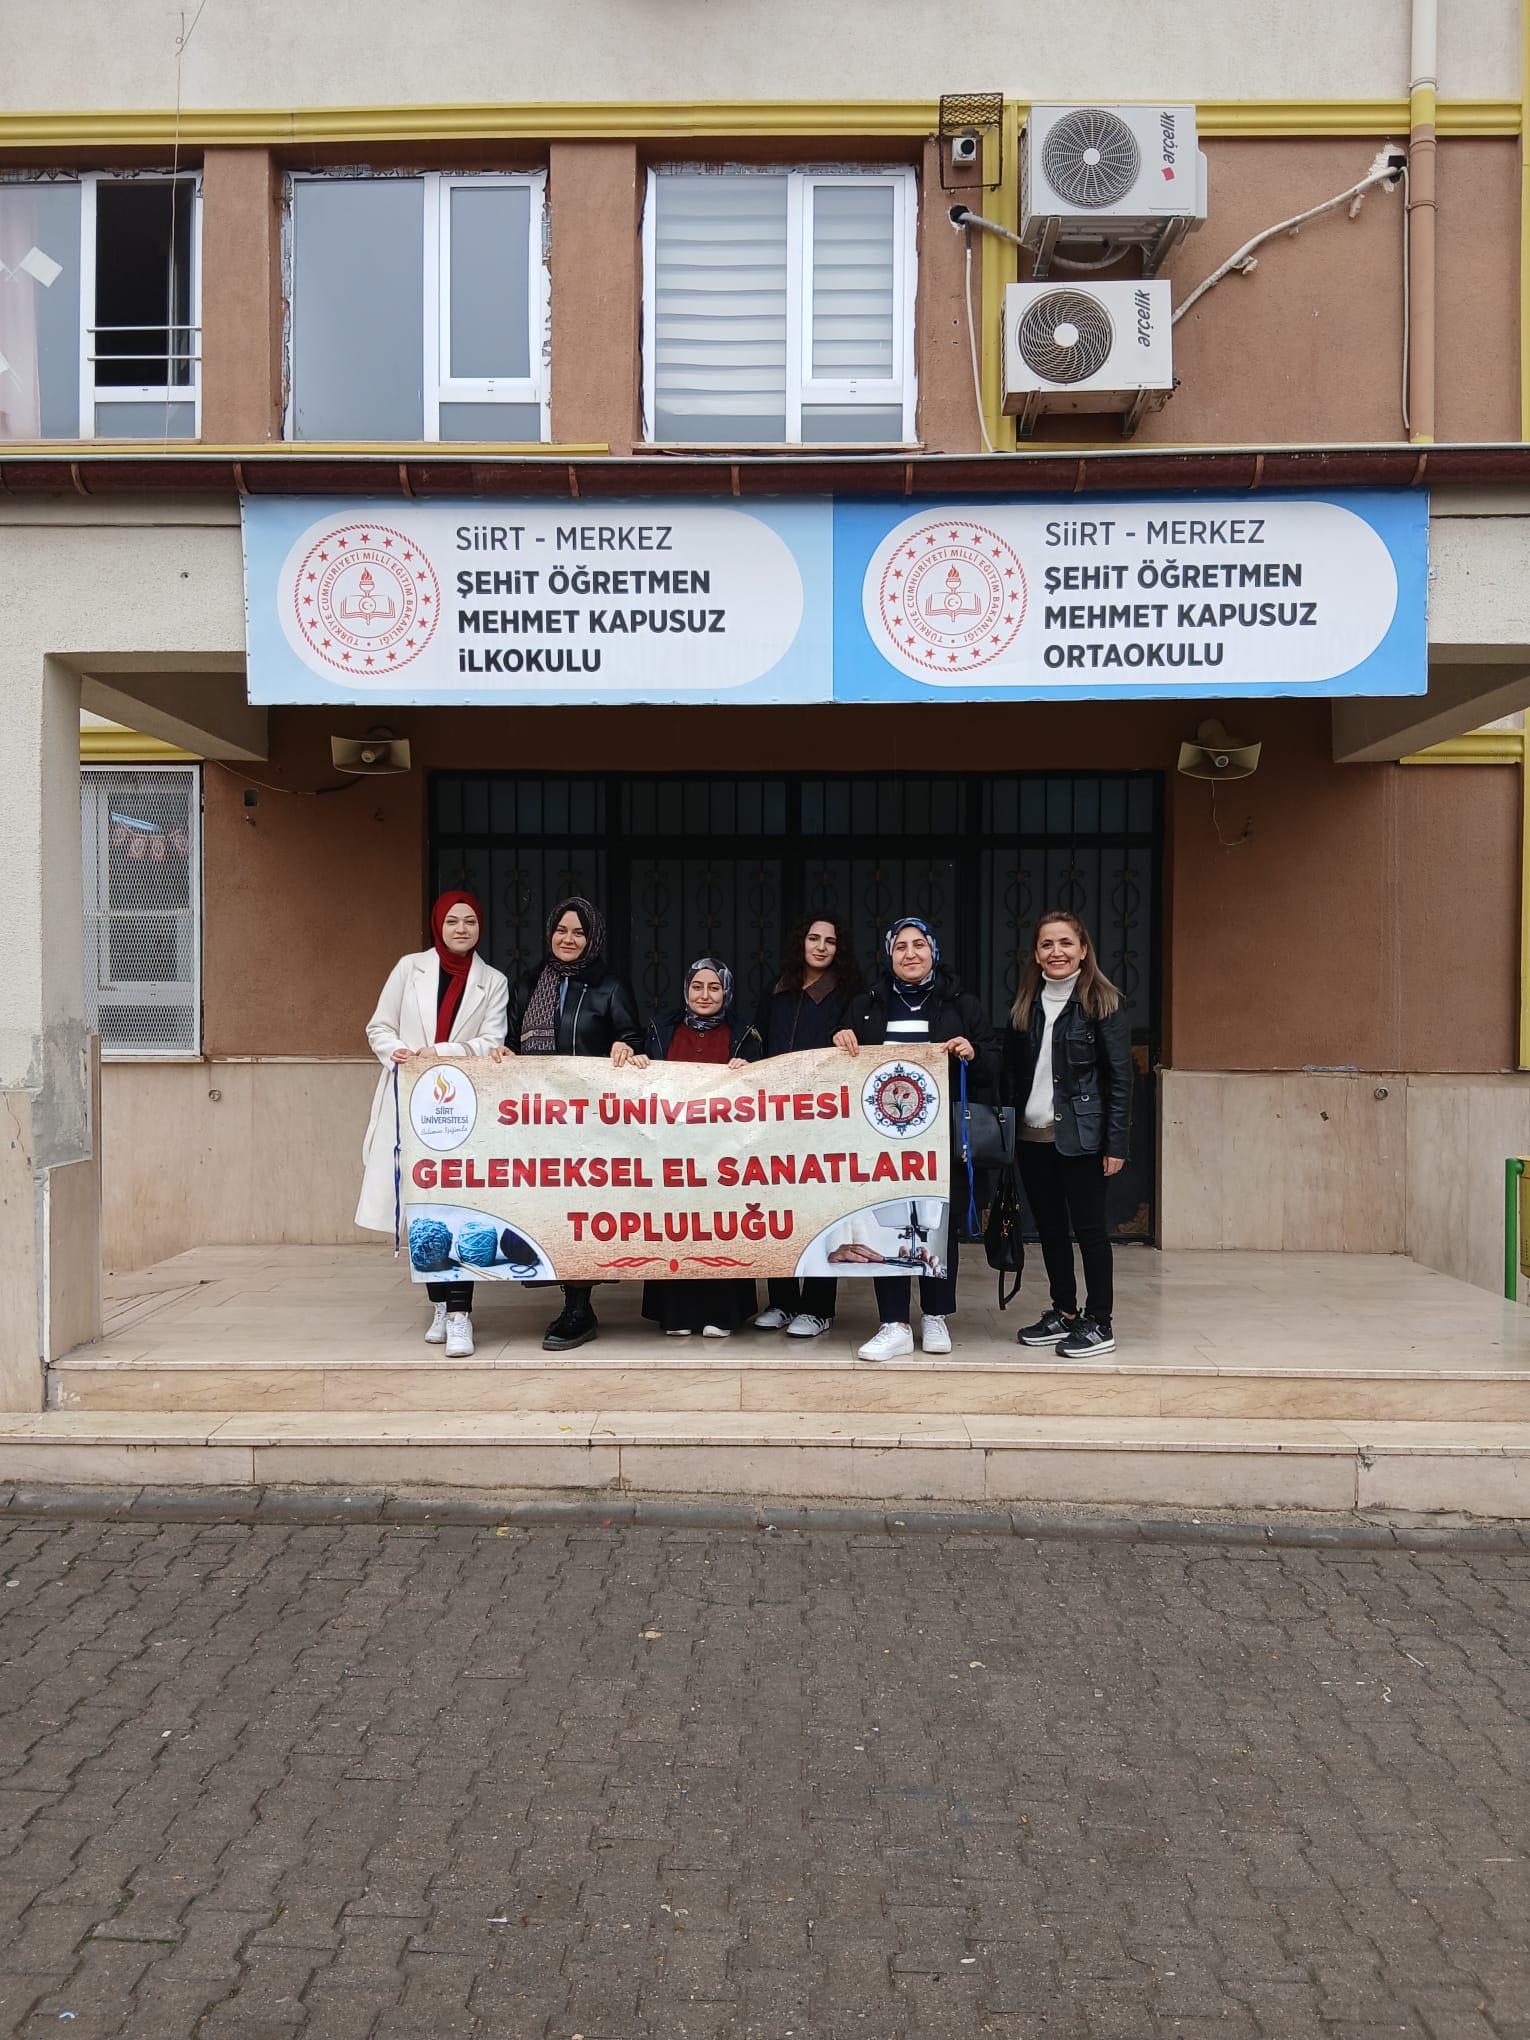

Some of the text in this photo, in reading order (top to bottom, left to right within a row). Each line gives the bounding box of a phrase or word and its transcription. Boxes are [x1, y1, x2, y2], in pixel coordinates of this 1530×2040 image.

[1160, 111, 1178, 164] arçelik
[1134, 289, 1154, 347] arçelik
[556, 526, 673, 551] MERKEZ
[1147, 519, 1265, 545] MERKEZ
[548, 565, 710, 595] ÖĞRETMEN
[1137, 558, 1302, 589] ÖĞRETMEN
[458, 609, 726, 634] MEHMET KAPUSUZ
[1044, 602, 1317, 630] MEHMET KAPUSUZ
[1043, 642, 1224, 669] ORTAOKULU
[499, 1094, 590, 1124] SİİRT
[599, 1086, 849, 1124] ÜNİVERSİTESİ
[412, 1151, 937, 1188] GELENEKSEL EL SANATLARI
[567, 1203, 793, 1242] TOPLULUĞU
